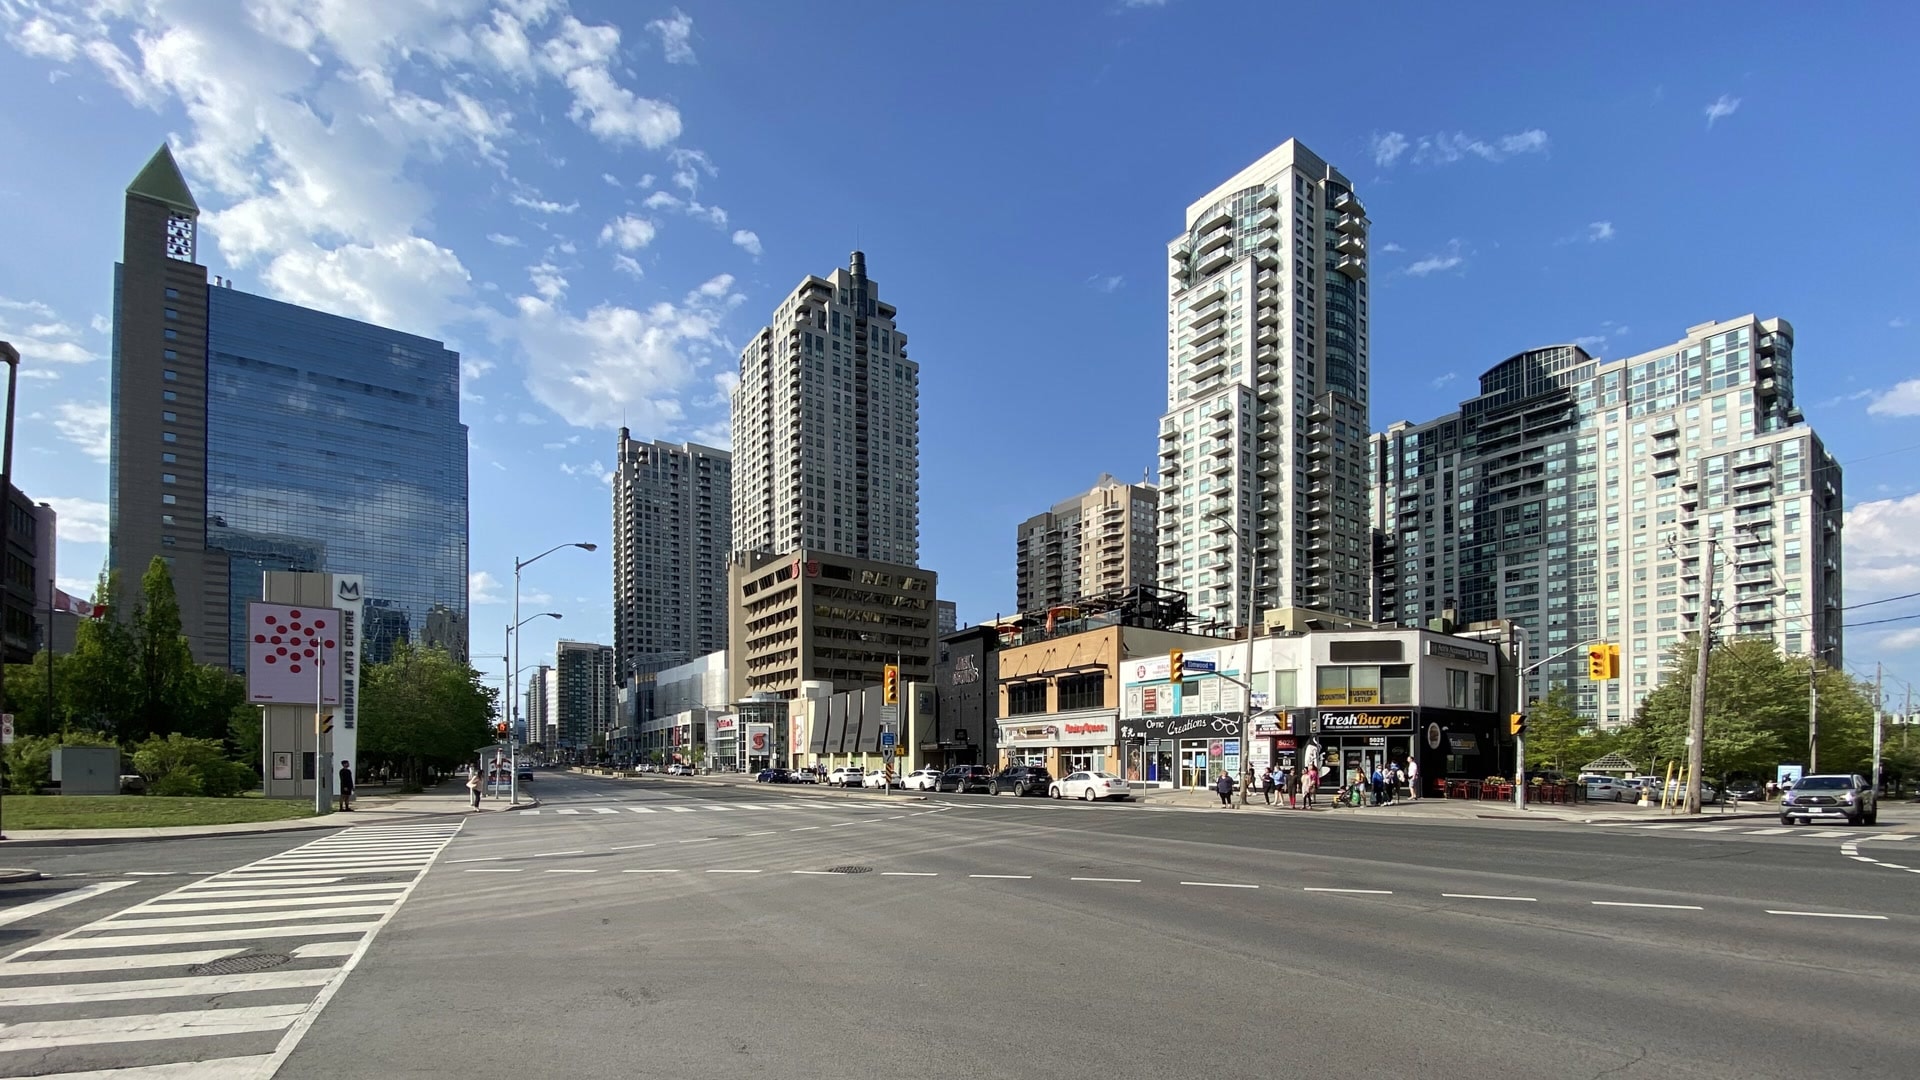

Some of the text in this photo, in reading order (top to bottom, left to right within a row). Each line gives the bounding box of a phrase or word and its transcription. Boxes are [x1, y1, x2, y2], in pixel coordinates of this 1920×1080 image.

[344, 610, 354, 729] MERIDIAN ARTS CENTRE
[1187, 661, 1209, 669] Elmwood
[1167, 719, 1207, 736] Creations
